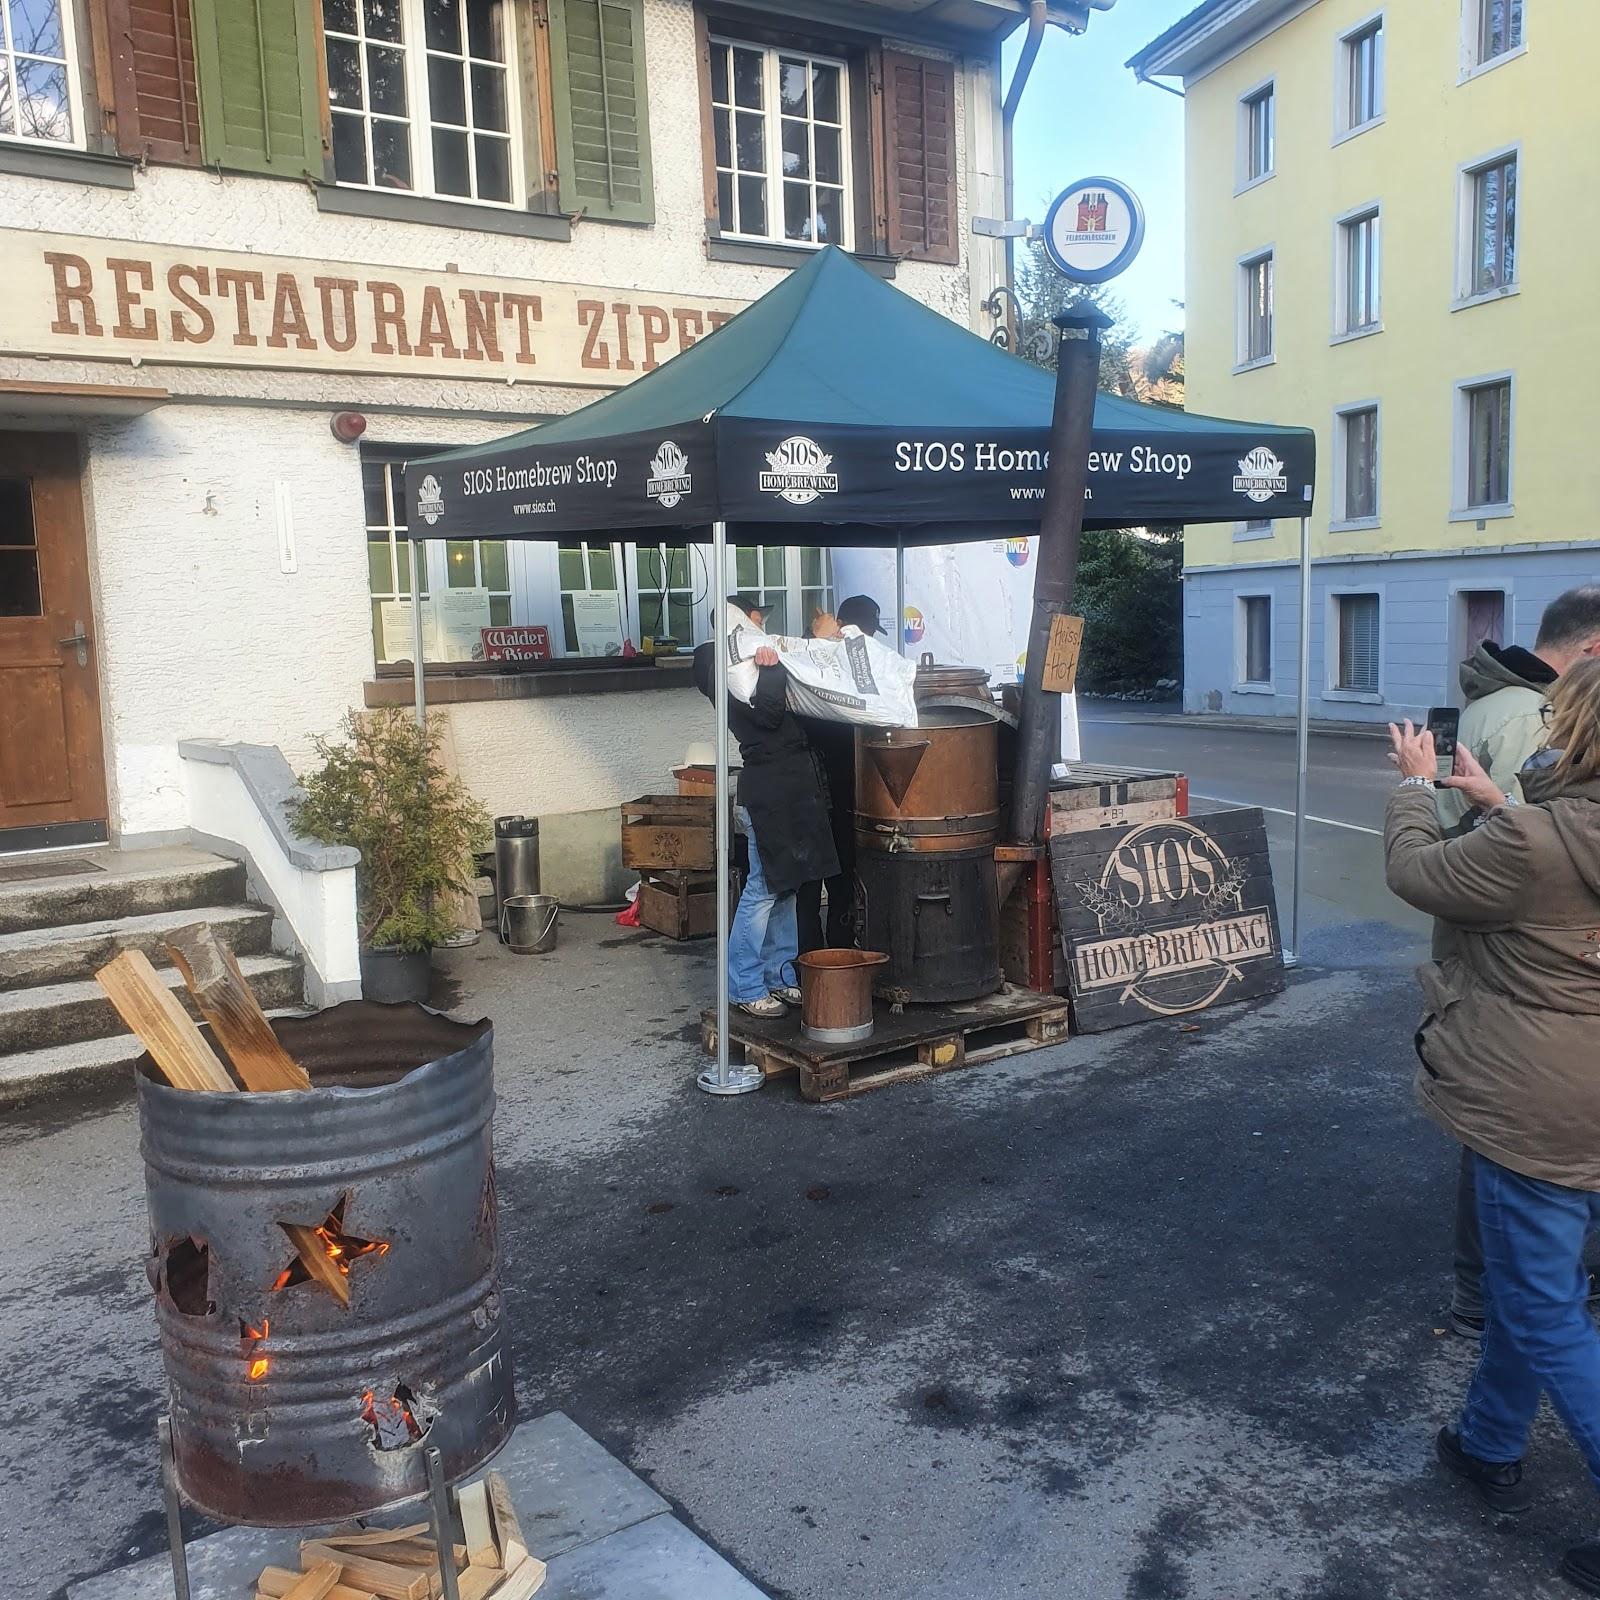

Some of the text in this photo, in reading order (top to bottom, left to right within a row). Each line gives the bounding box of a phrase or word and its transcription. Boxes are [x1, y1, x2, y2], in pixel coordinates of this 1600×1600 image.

[44, 251, 542, 364] RESTAURANT
[657, 446, 680, 470] SIOS
[780, 442, 819, 466] SIOS
[894, 441, 1192, 480] SIOS Homew Shop
[1248, 451, 1275, 470] SIOS
[463, 455, 617, 496] SIOS Homebrew Shop
[762, 475, 836, 489] HOMEBREWING
[1235, 478, 1285, 490] HOMEBREWING
[513, 499, 556, 515] www.sios.ch
[487, 630, 545, 647] Walder
[1046, 652, 1076, 681] Hot
[1114, 835, 1216, 908] SIOS
[1080, 917, 1266, 982] HOMEBREWING
